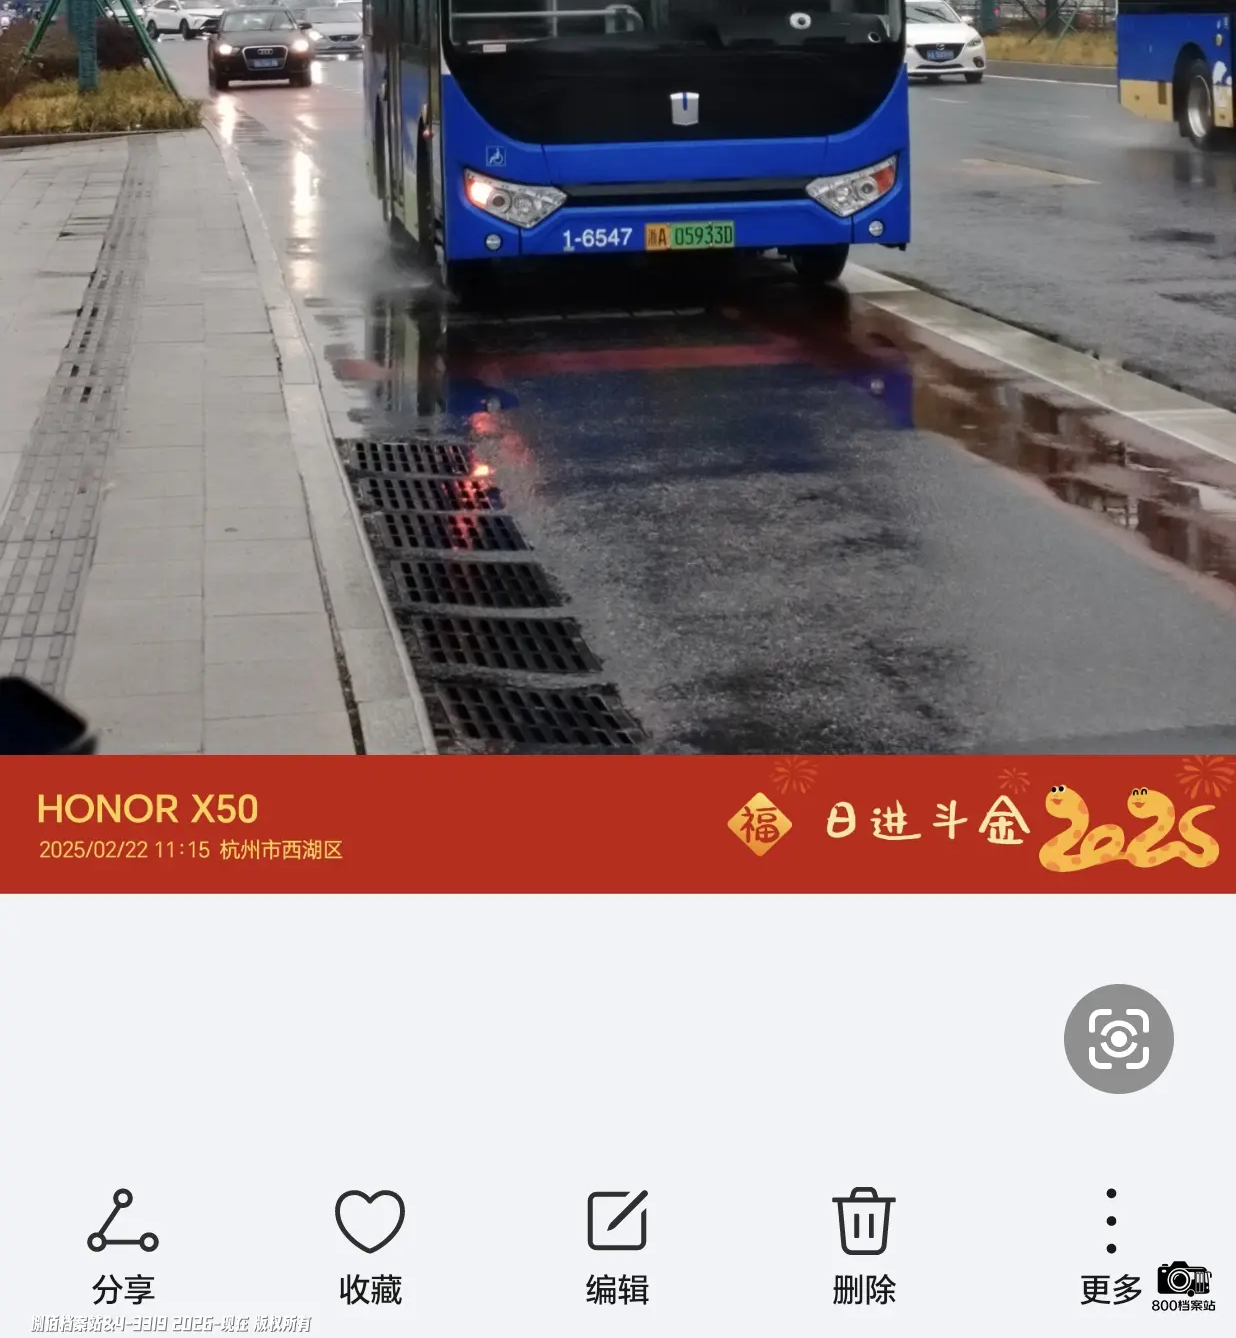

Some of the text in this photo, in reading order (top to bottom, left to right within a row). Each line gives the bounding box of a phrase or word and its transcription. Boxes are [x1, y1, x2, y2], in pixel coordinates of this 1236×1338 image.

[563, 227, 633, 252] 1-6547
[674, 225, 733, 246] 05933D
[92, 1274, 155, 1305] 分享
[340, 1274, 402, 1305] 收藏
[586, 1274, 649, 1305] 编辑
[833, 1274, 896, 1305] 删除
[1081, 1274, 1142, 1305] 更多
